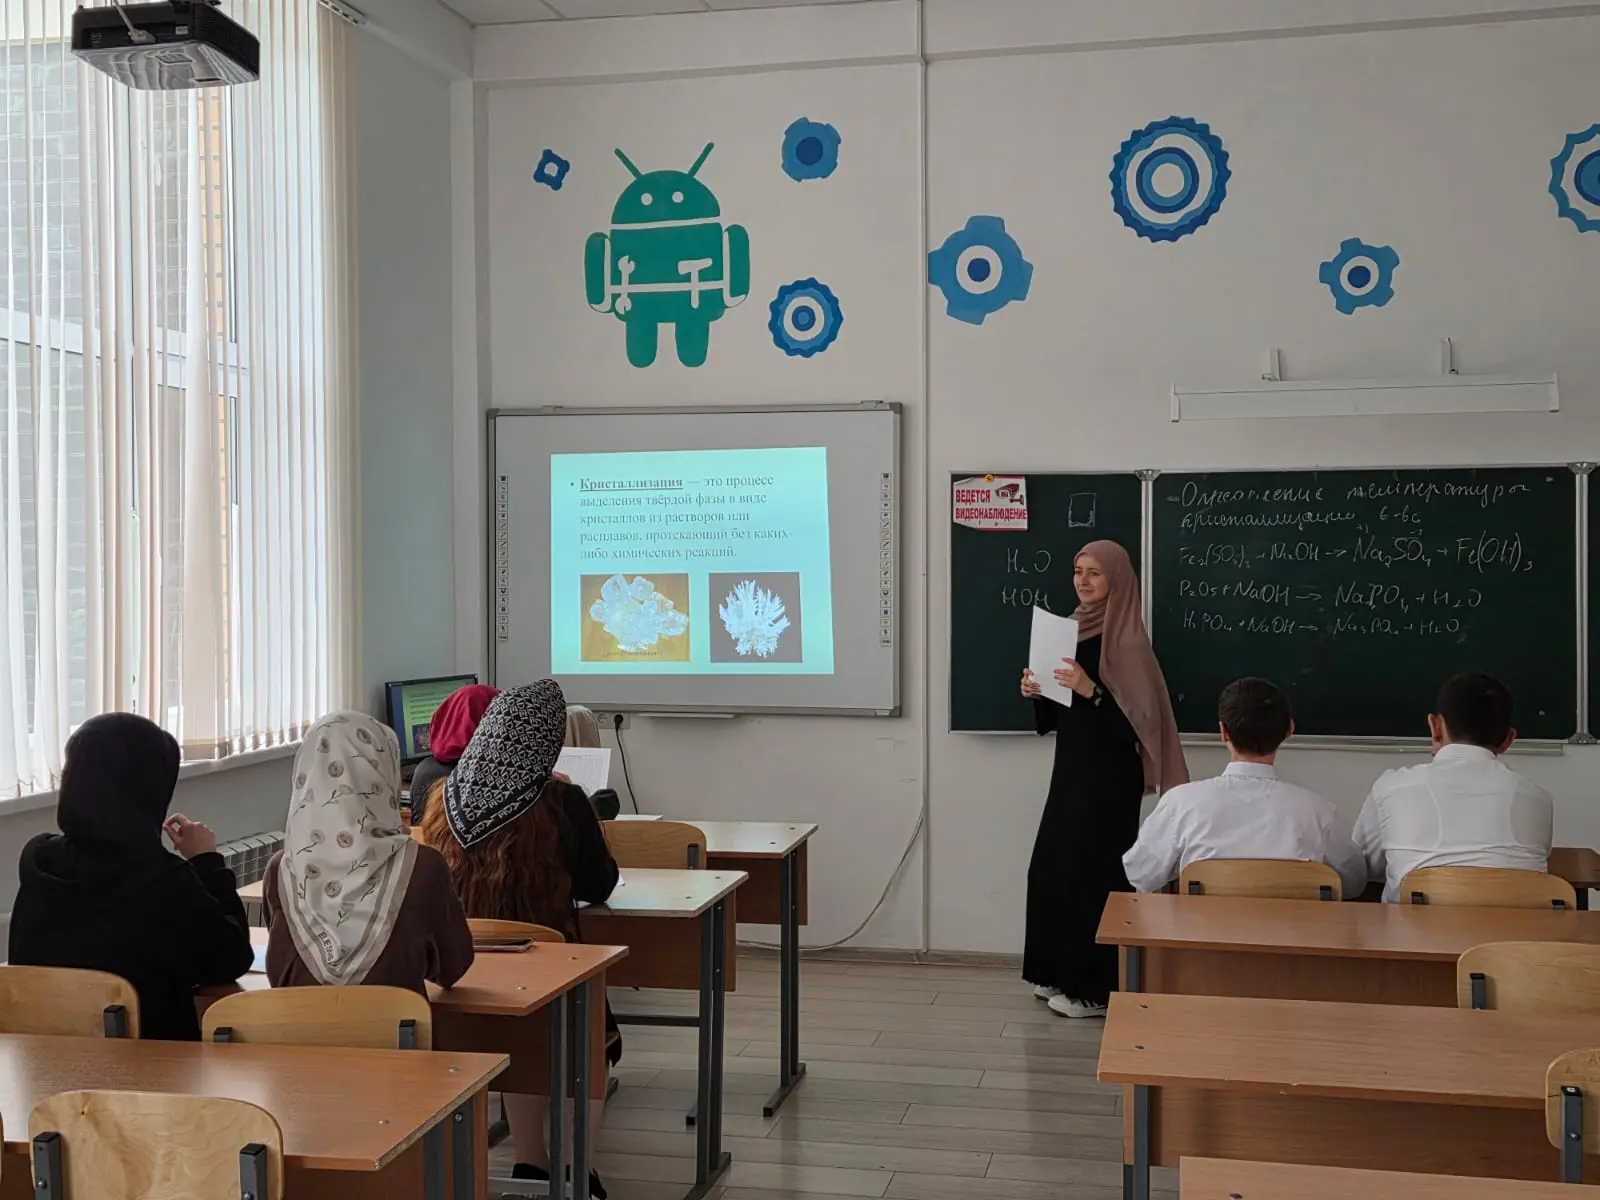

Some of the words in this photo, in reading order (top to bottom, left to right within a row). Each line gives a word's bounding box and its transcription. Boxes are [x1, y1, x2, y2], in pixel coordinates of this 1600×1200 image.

[580, 478, 684, 492] Кристаллизация
[704, 478, 723, 488] это
[726, 475, 774, 489] процесс
[580, 496, 642, 507] выделения
[696, 492, 726, 508] фазы
[739, 494, 767, 506] виде
[955, 489, 991, 505] ВЕДЕТСЯ
[580, 515, 646, 526] кристаллов
[649, 515, 662, 523] из
[665, 512, 725, 526] растворов
[728, 513, 750, 521] или
[955, 507, 1027, 521] ВИДЕОНАБЛЮДЕНИЕ
[731, 527, 751, 539] без
[580, 547, 608, 559] либо
[611, 549, 681, 559] химических
